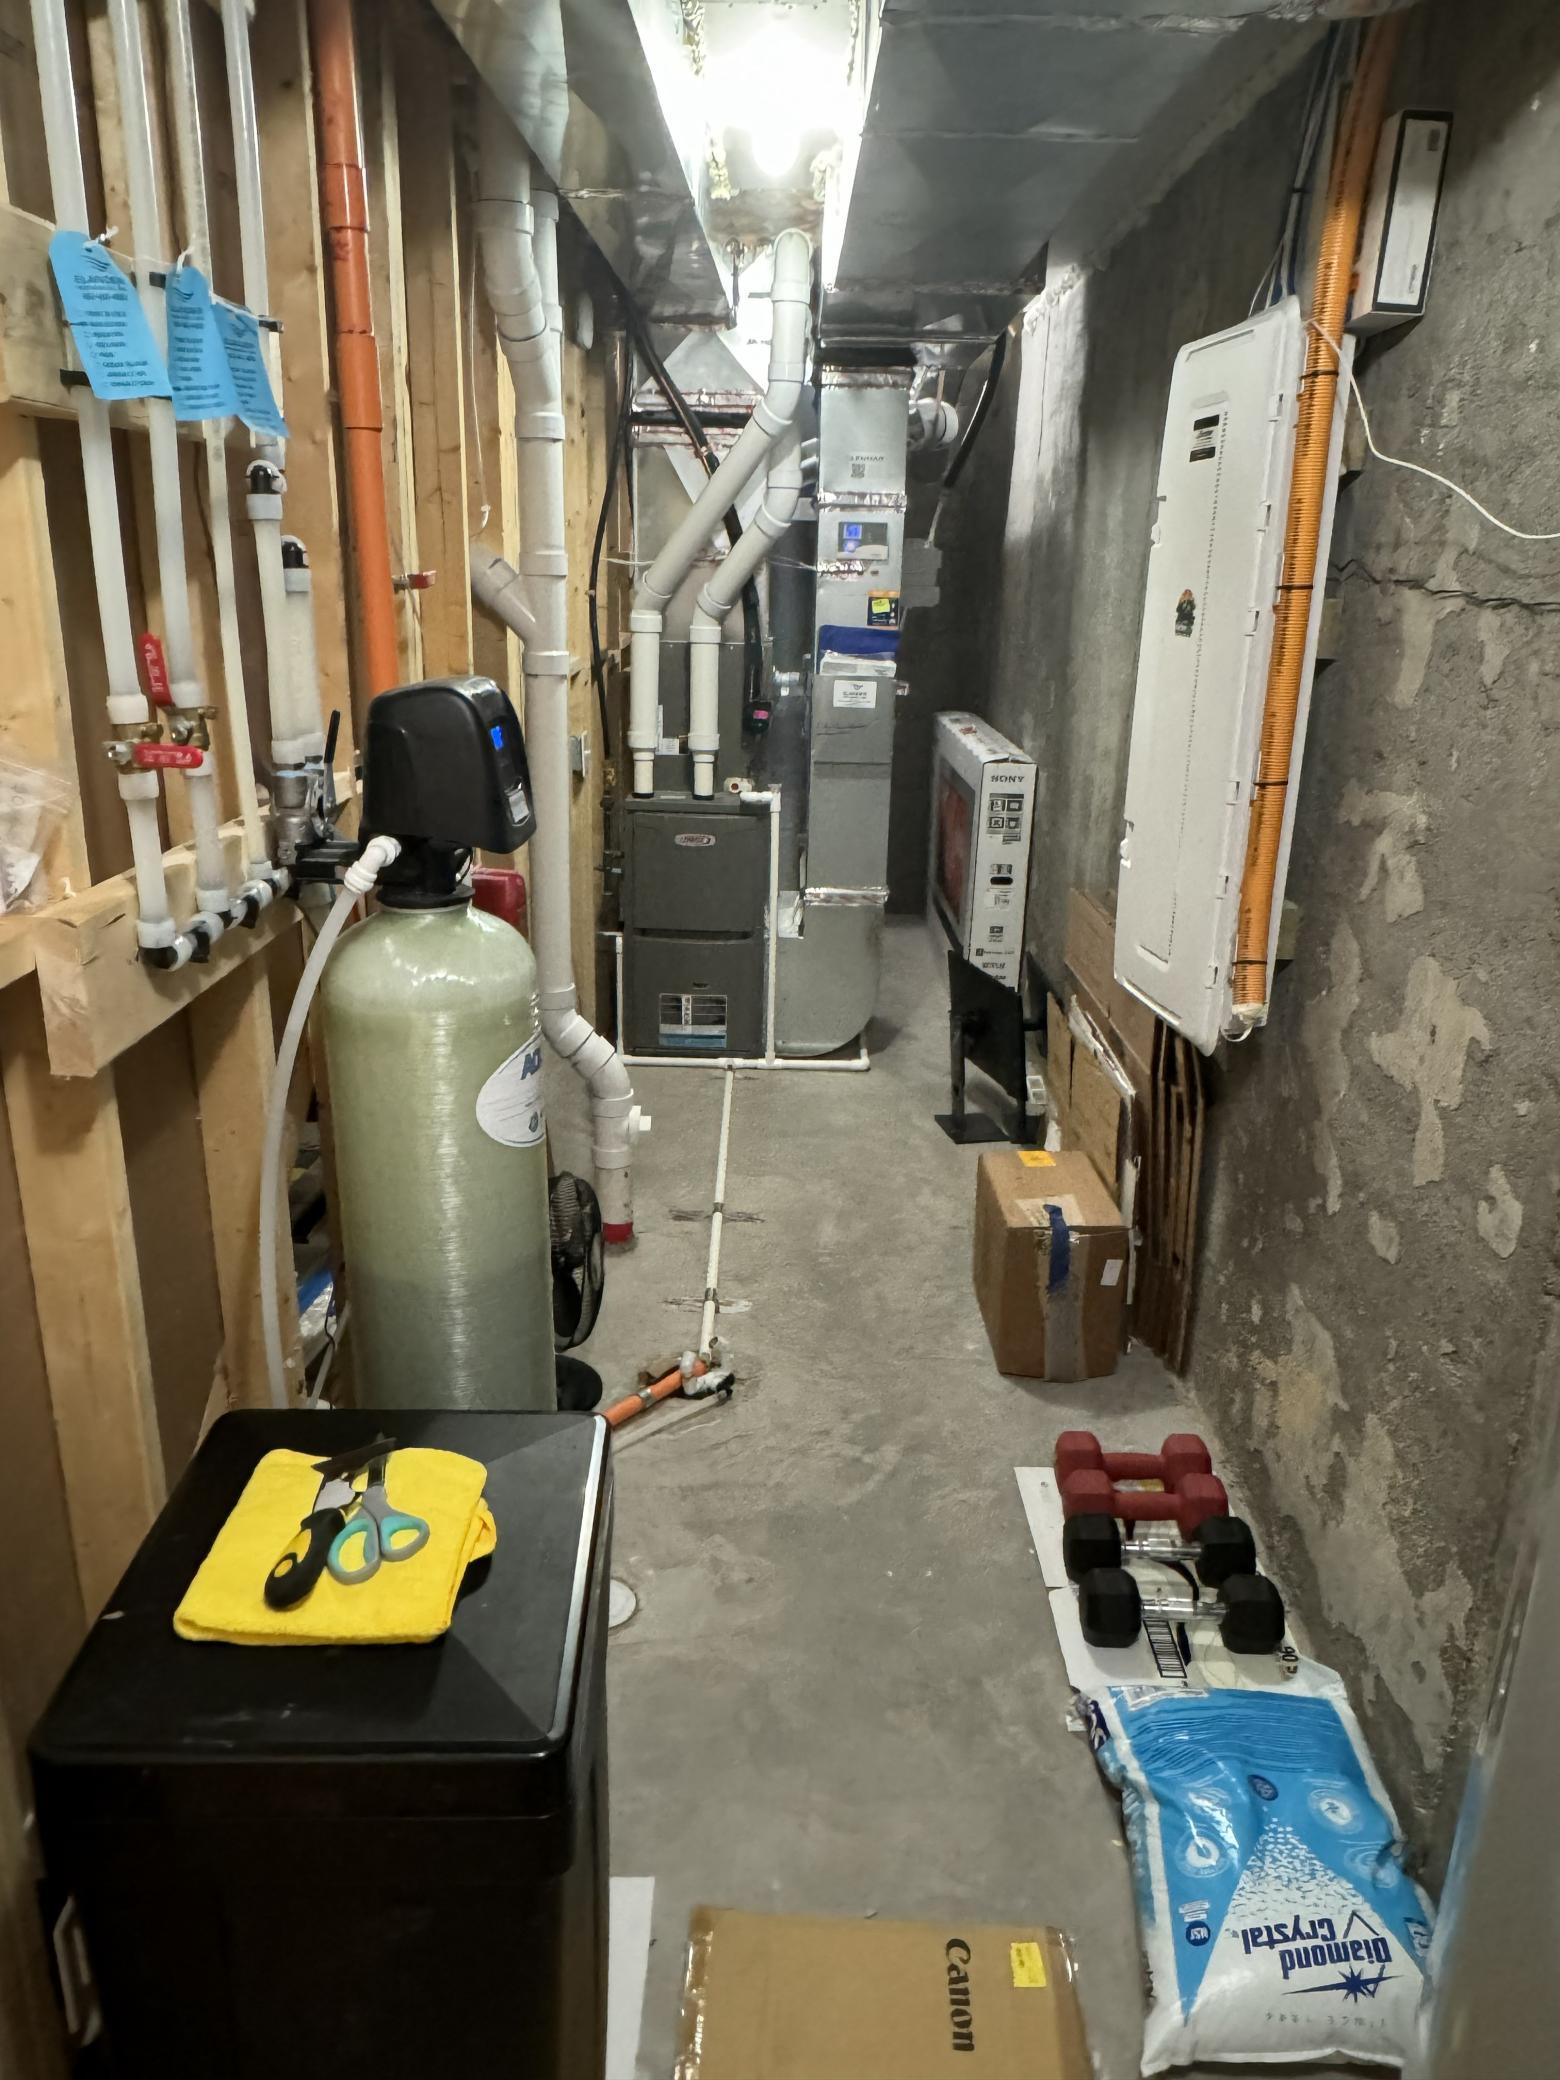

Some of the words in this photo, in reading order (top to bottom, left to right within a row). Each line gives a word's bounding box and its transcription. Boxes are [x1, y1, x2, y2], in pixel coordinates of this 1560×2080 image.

[991, 775, 1025, 783] SONY
[1241, 1914, 1337, 1955] Crystal
[1279, 1936, 1393, 1980] Diamond
[946, 1938, 975, 2052] Canon
